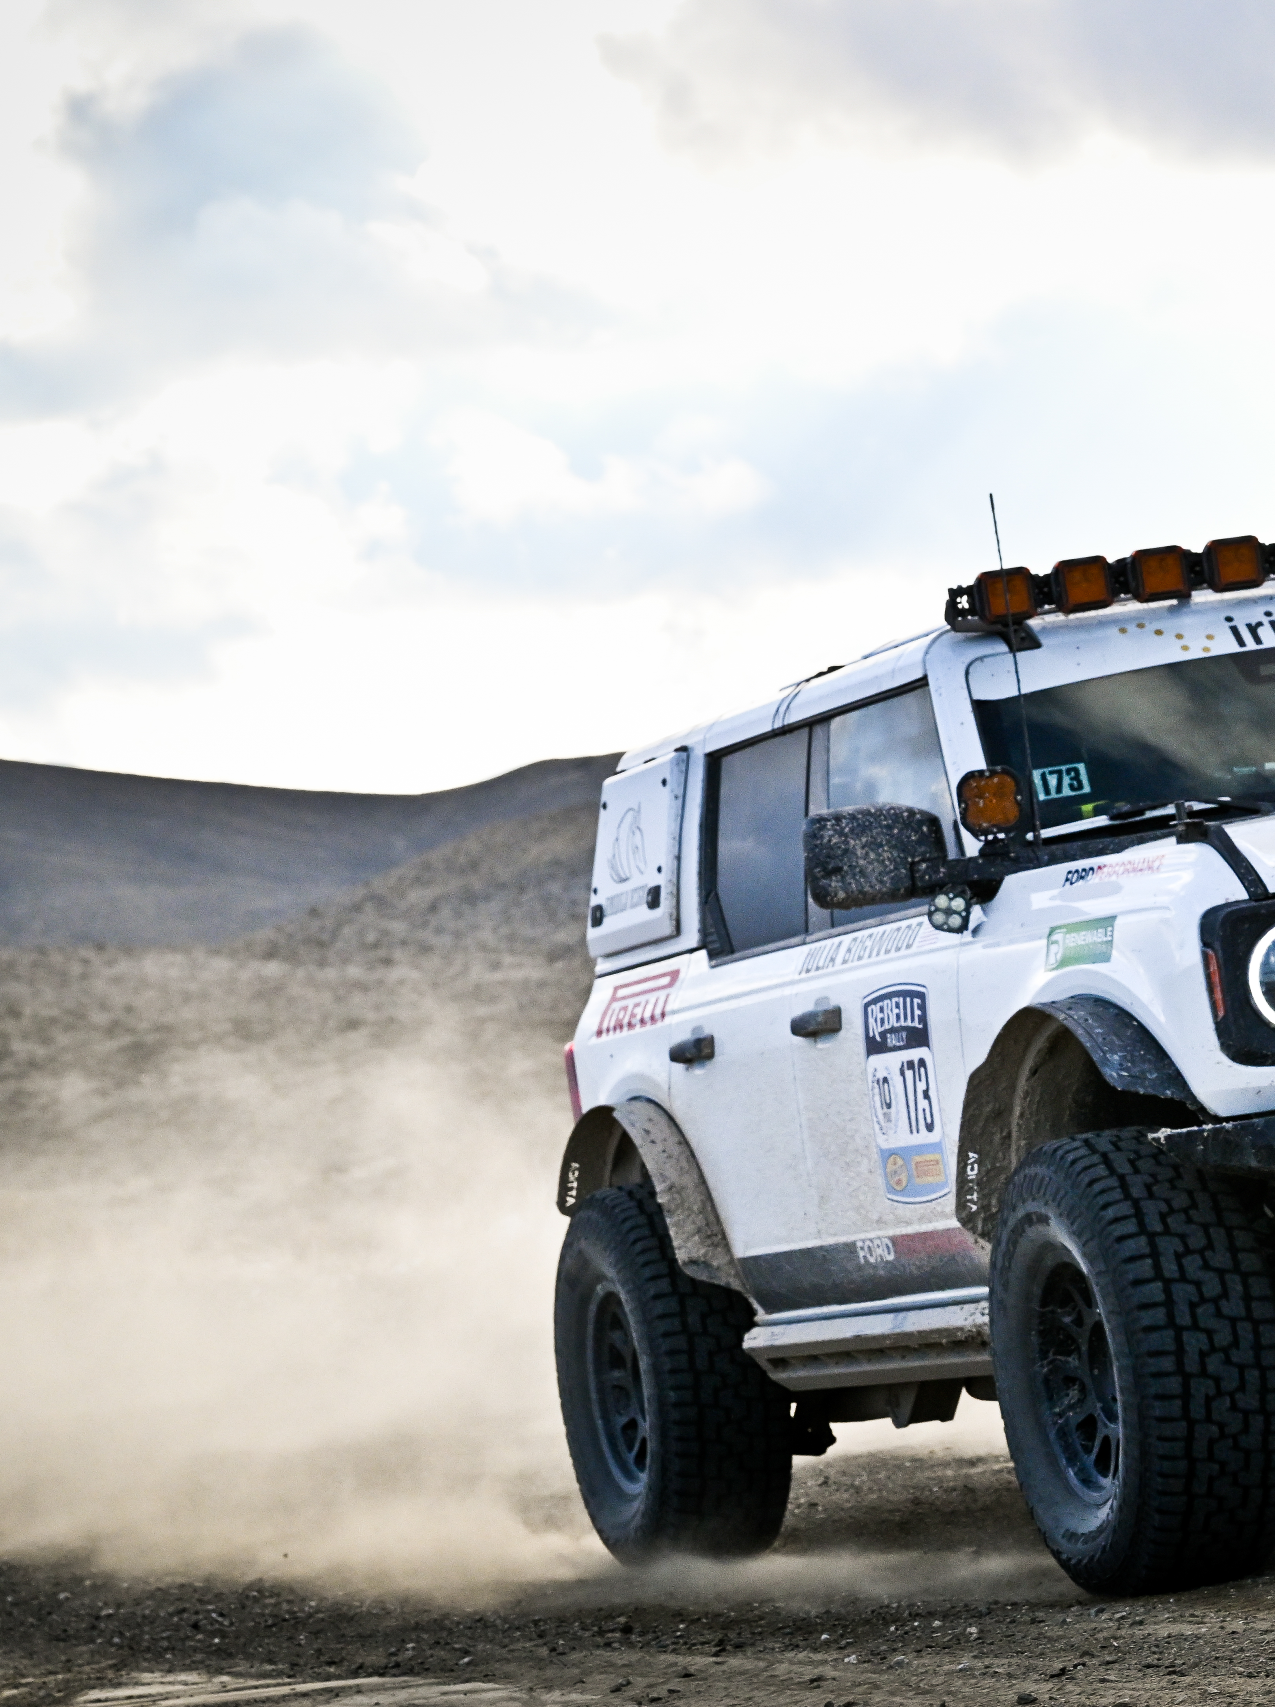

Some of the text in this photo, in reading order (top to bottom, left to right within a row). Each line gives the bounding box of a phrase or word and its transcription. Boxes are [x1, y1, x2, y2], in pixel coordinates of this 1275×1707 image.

[1040, 765, 1084, 797] 173
[798, 921, 925, 976] JULIA BIGWOOD
[596, 969, 681, 1039] PIRELLI
[867, 996, 924, 1042] REBELLE
[886, 1030, 908, 1048] RALLY
[876, 1076, 892, 1110] 10
[899, 1057, 935, 1136] 173
[856, 1237, 896, 1264] FORD
